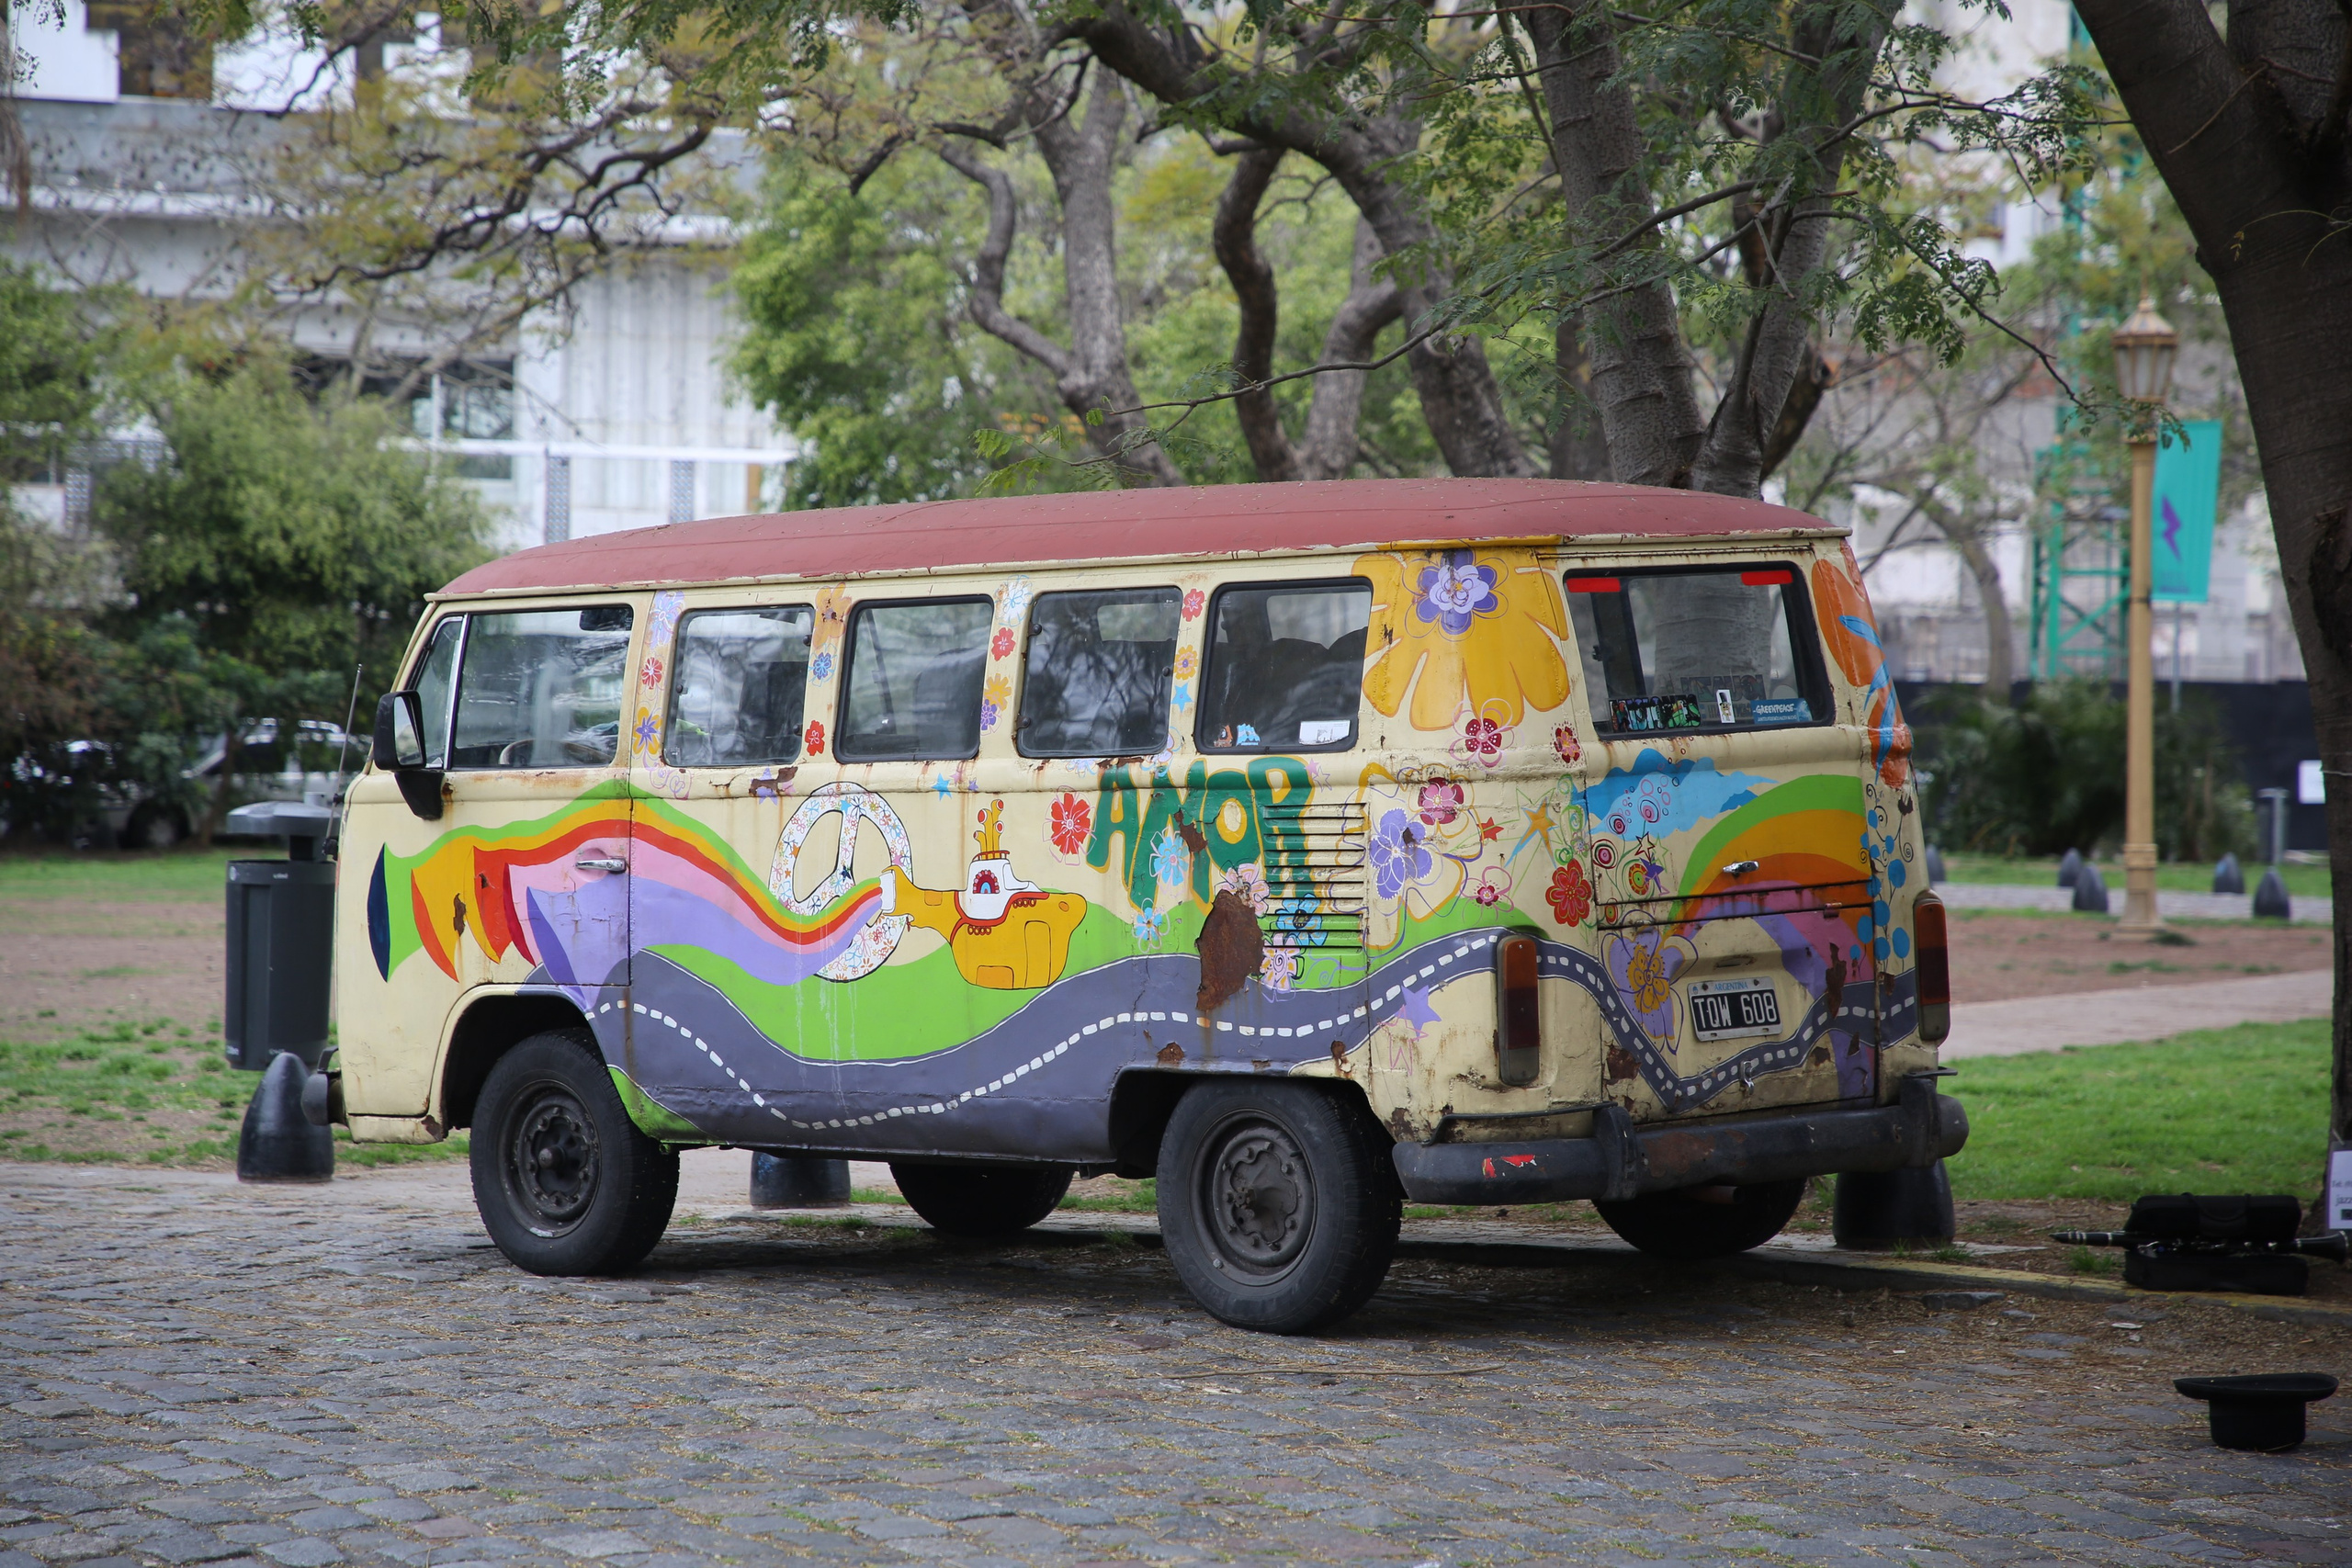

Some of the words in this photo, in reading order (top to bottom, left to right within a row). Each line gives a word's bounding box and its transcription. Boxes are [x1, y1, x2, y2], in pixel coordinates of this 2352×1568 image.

[1086, 756, 1318, 917] AMOR
[1714, 982, 1748, 991] ARGENTINA
[1694, 996, 1732, 1029] TQW
[1740, 992, 1778, 1025] 608
